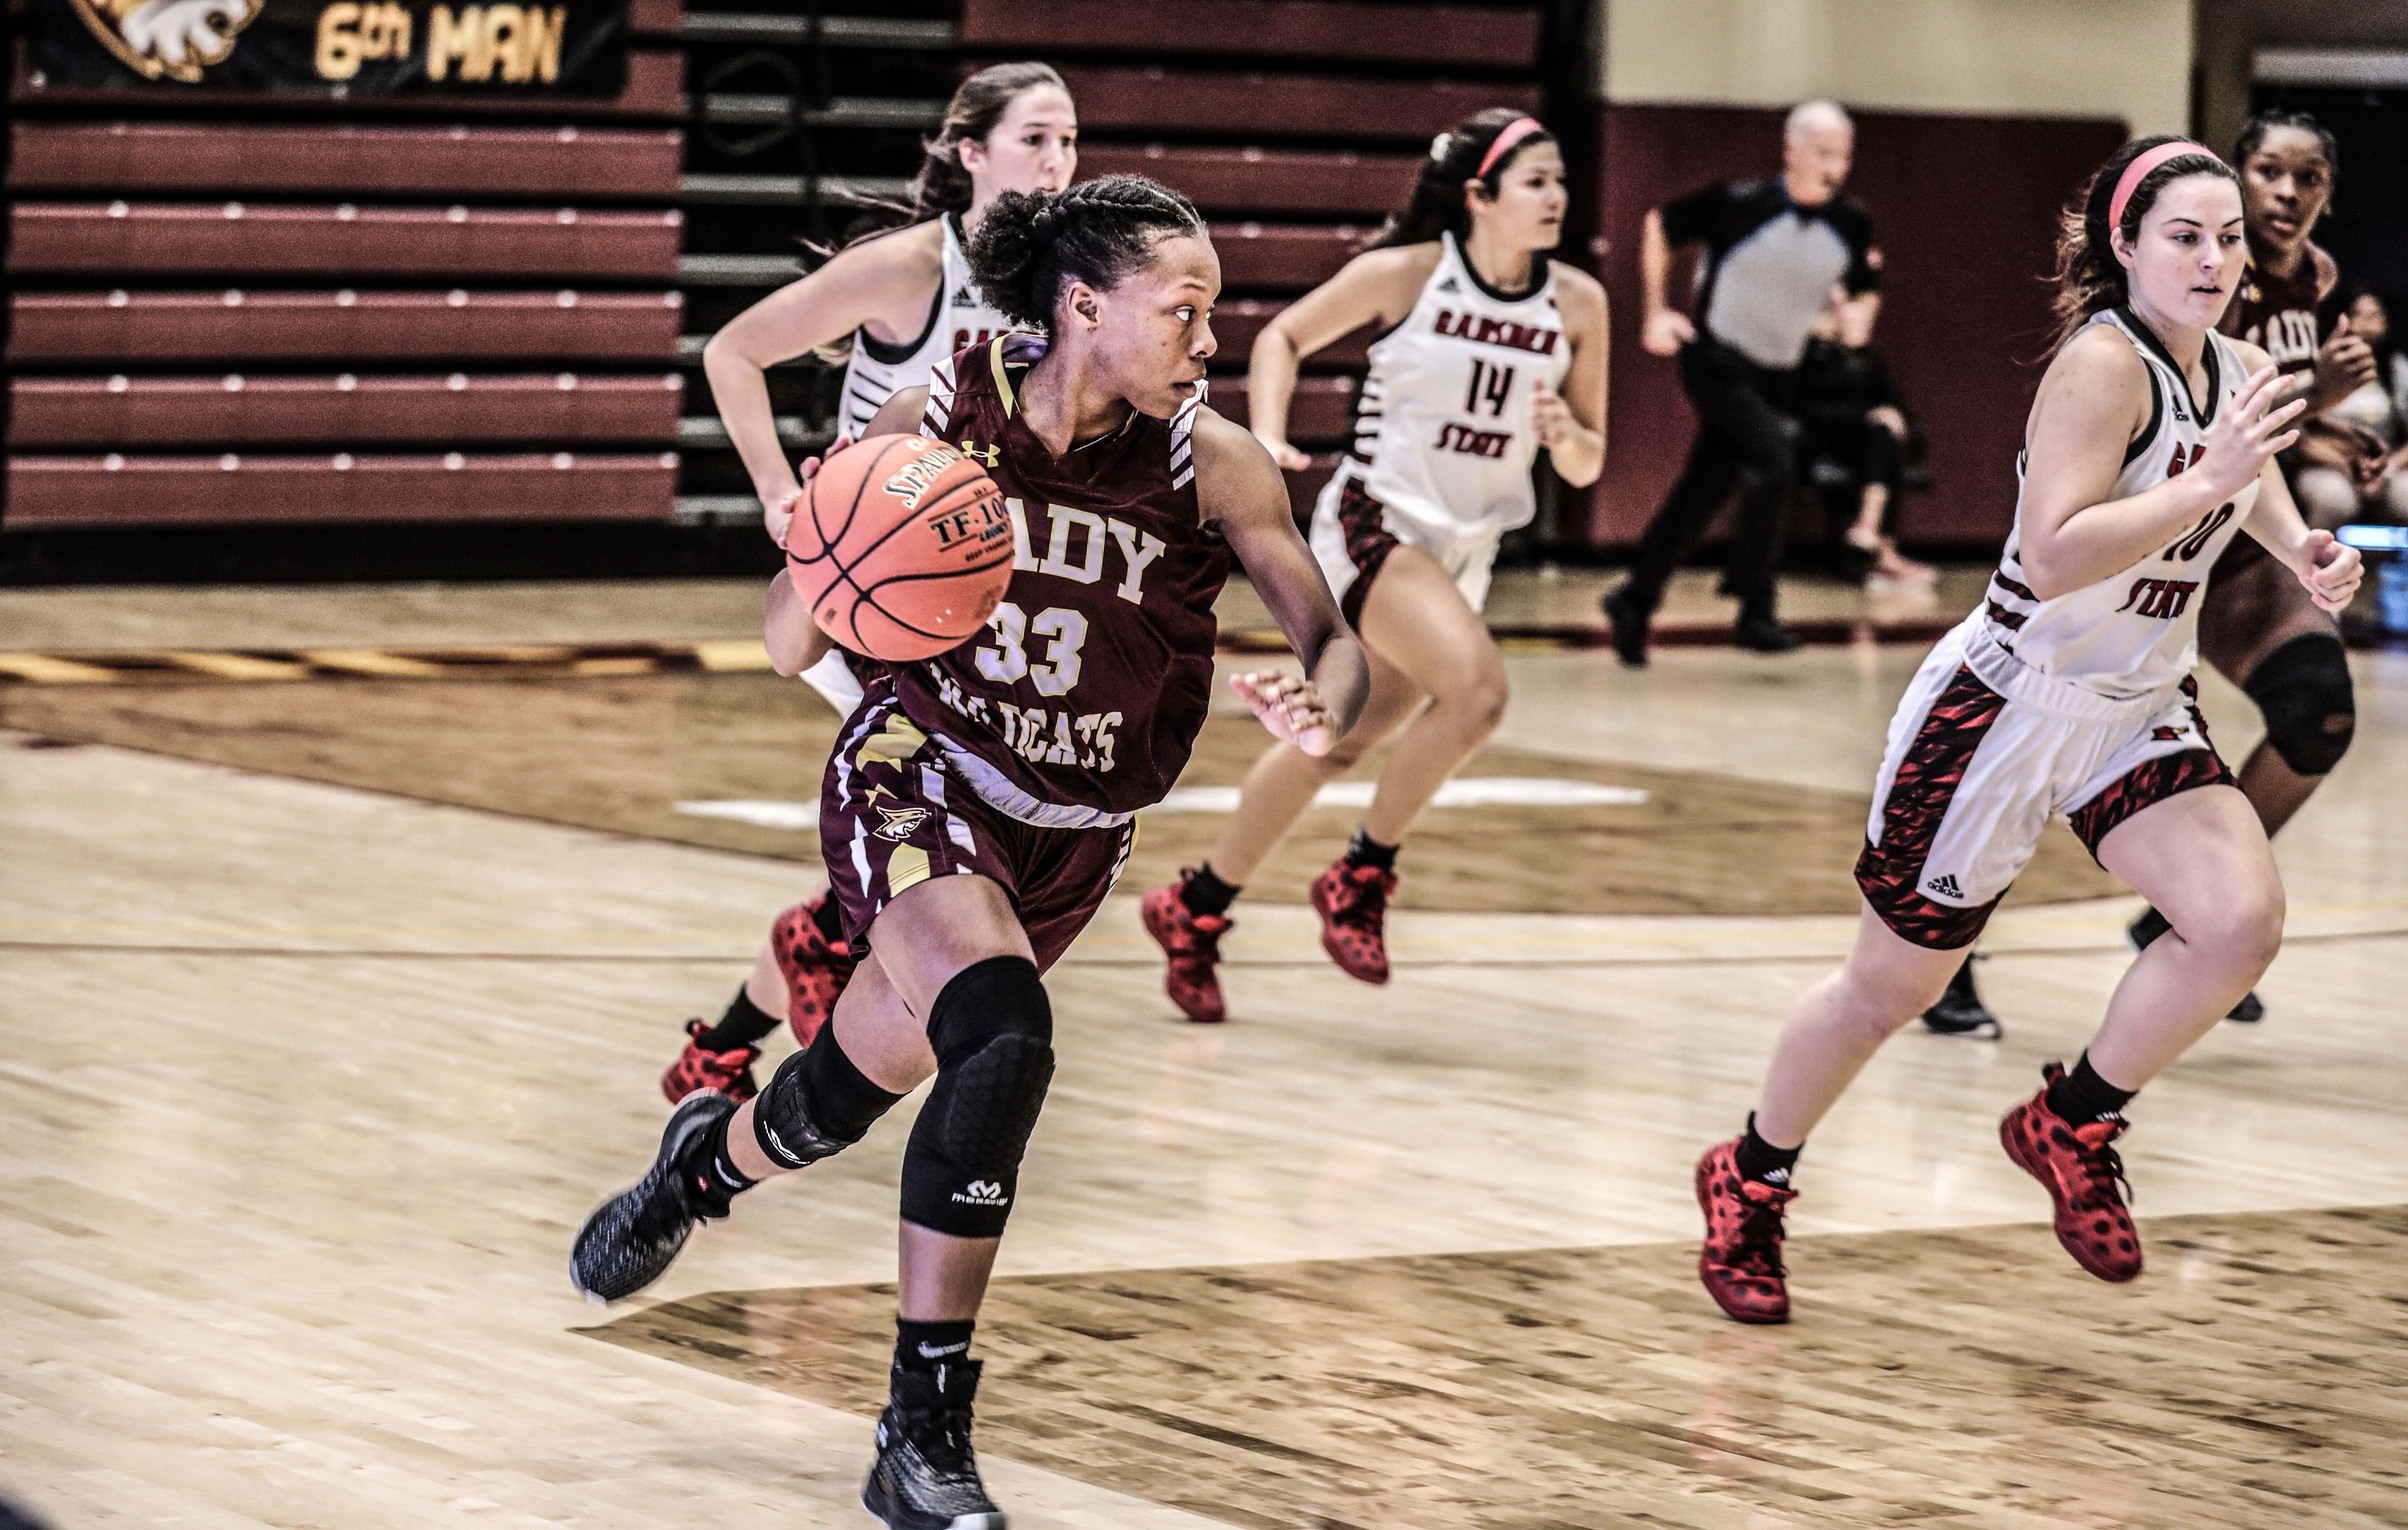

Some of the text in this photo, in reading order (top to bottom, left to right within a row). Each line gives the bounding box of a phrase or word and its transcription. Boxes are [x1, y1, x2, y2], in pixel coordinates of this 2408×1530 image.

[314, 2, 567, 83] 6th MAN
[1466, 358, 1514, 417] 14
[1004, 497, 1167, 605] ADY
[974, 601, 1089, 698] 33
[1927, 880, 1964, 899] adidas
